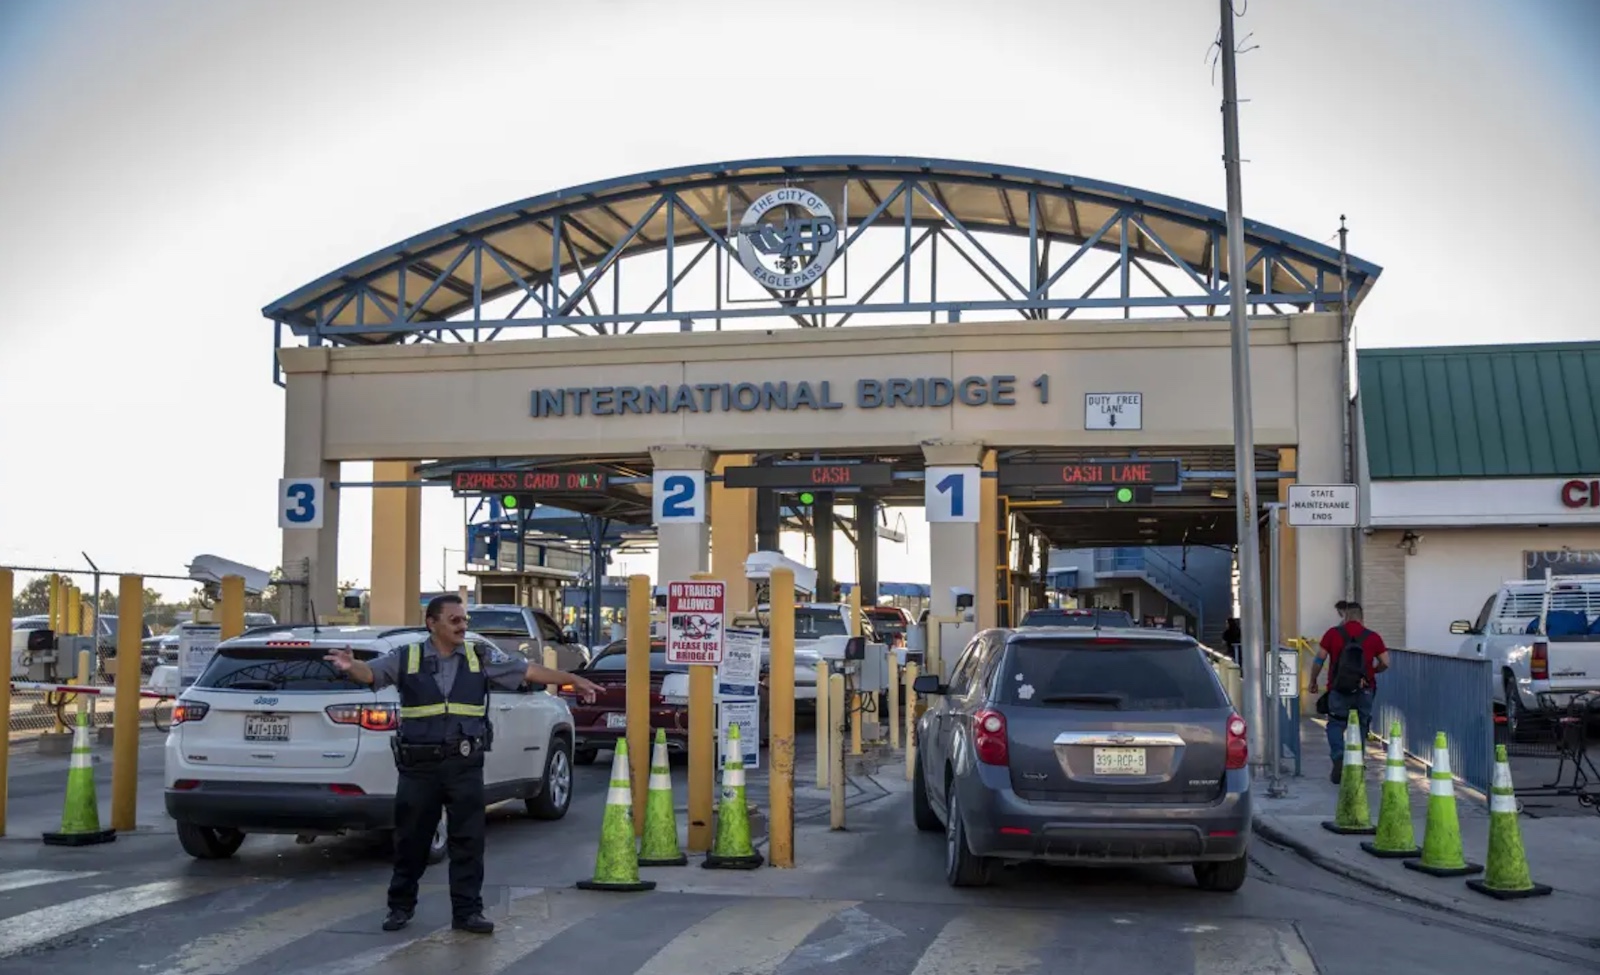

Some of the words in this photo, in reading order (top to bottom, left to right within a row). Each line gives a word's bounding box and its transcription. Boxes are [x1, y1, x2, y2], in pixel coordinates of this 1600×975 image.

[752, 195, 775, 214] THE
[777, 190, 805, 200] CITY
[807, 196, 823, 211] OF
[753, 266, 791, 287] EAGLE
[794, 263, 822, 285] PASS
[530, 380, 843, 417] INTERNATIONAL
[857, 375, 1016, 408] BRIDGE
[1034, 373, 1050, 405] 1
[1088, 396, 1111, 405] DUTY
[1117, 395, 1139, 404] FREE
[1101, 405, 1123, 414] LANE
[456, 472, 518, 489] EXPRESS
[524, 473, 559, 489] CARD
[567, 473, 604, 489] ONLY
[812, 467, 850, 484] CASH
[1062, 465, 1103, 482] CASH
[1111, 464, 1152, 482] LANE
[662, 475, 696, 517] 2
[935, 473, 965, 517] 1
[1310, 490, 1335, 498] STATE
[286, 483, 316, 523] 3
[671, 584, 683, 596] NO
[684, 584, 722, 597] TRAILERS
[677, 598, 715, 611] ALLOWED
[672, 641, 701, 650] PLEASE
[703, 642, 718, 651] USE
[676, 651, 707, 660] BRIDGE
[708, 652, 715, 660] II
